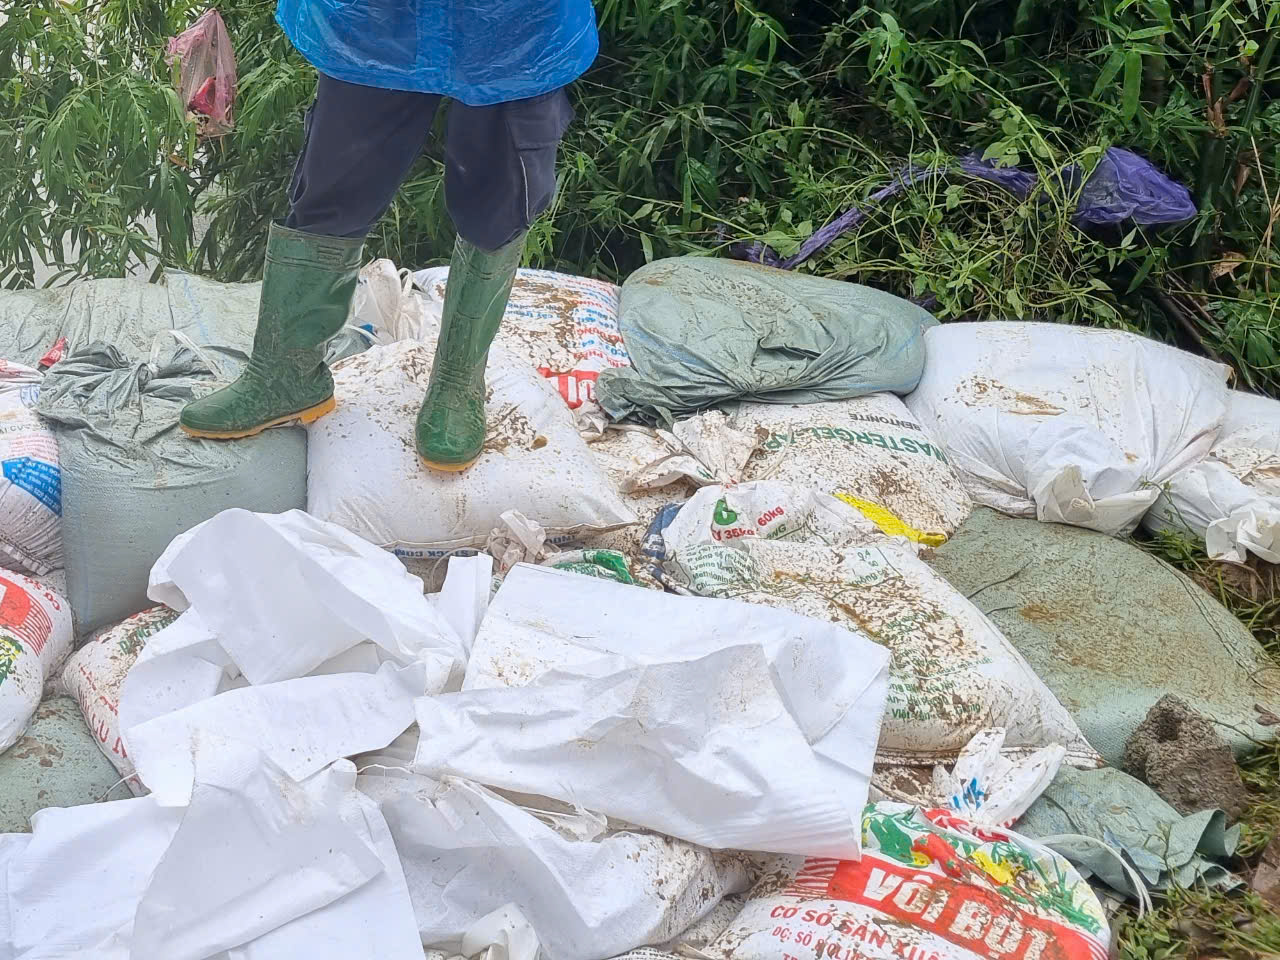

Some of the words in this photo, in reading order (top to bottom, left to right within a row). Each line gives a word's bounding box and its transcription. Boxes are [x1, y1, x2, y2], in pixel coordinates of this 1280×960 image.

[848, 413, 922, 431] BENTONITE
[758, 506, 785, 527] 60kg
[862, 867, 950, 924] VÔI
[770, 904, 801, 920] CƠ
[801, 904, 837, 927] SỞ
[839, 919, 889, 949] SẢN
